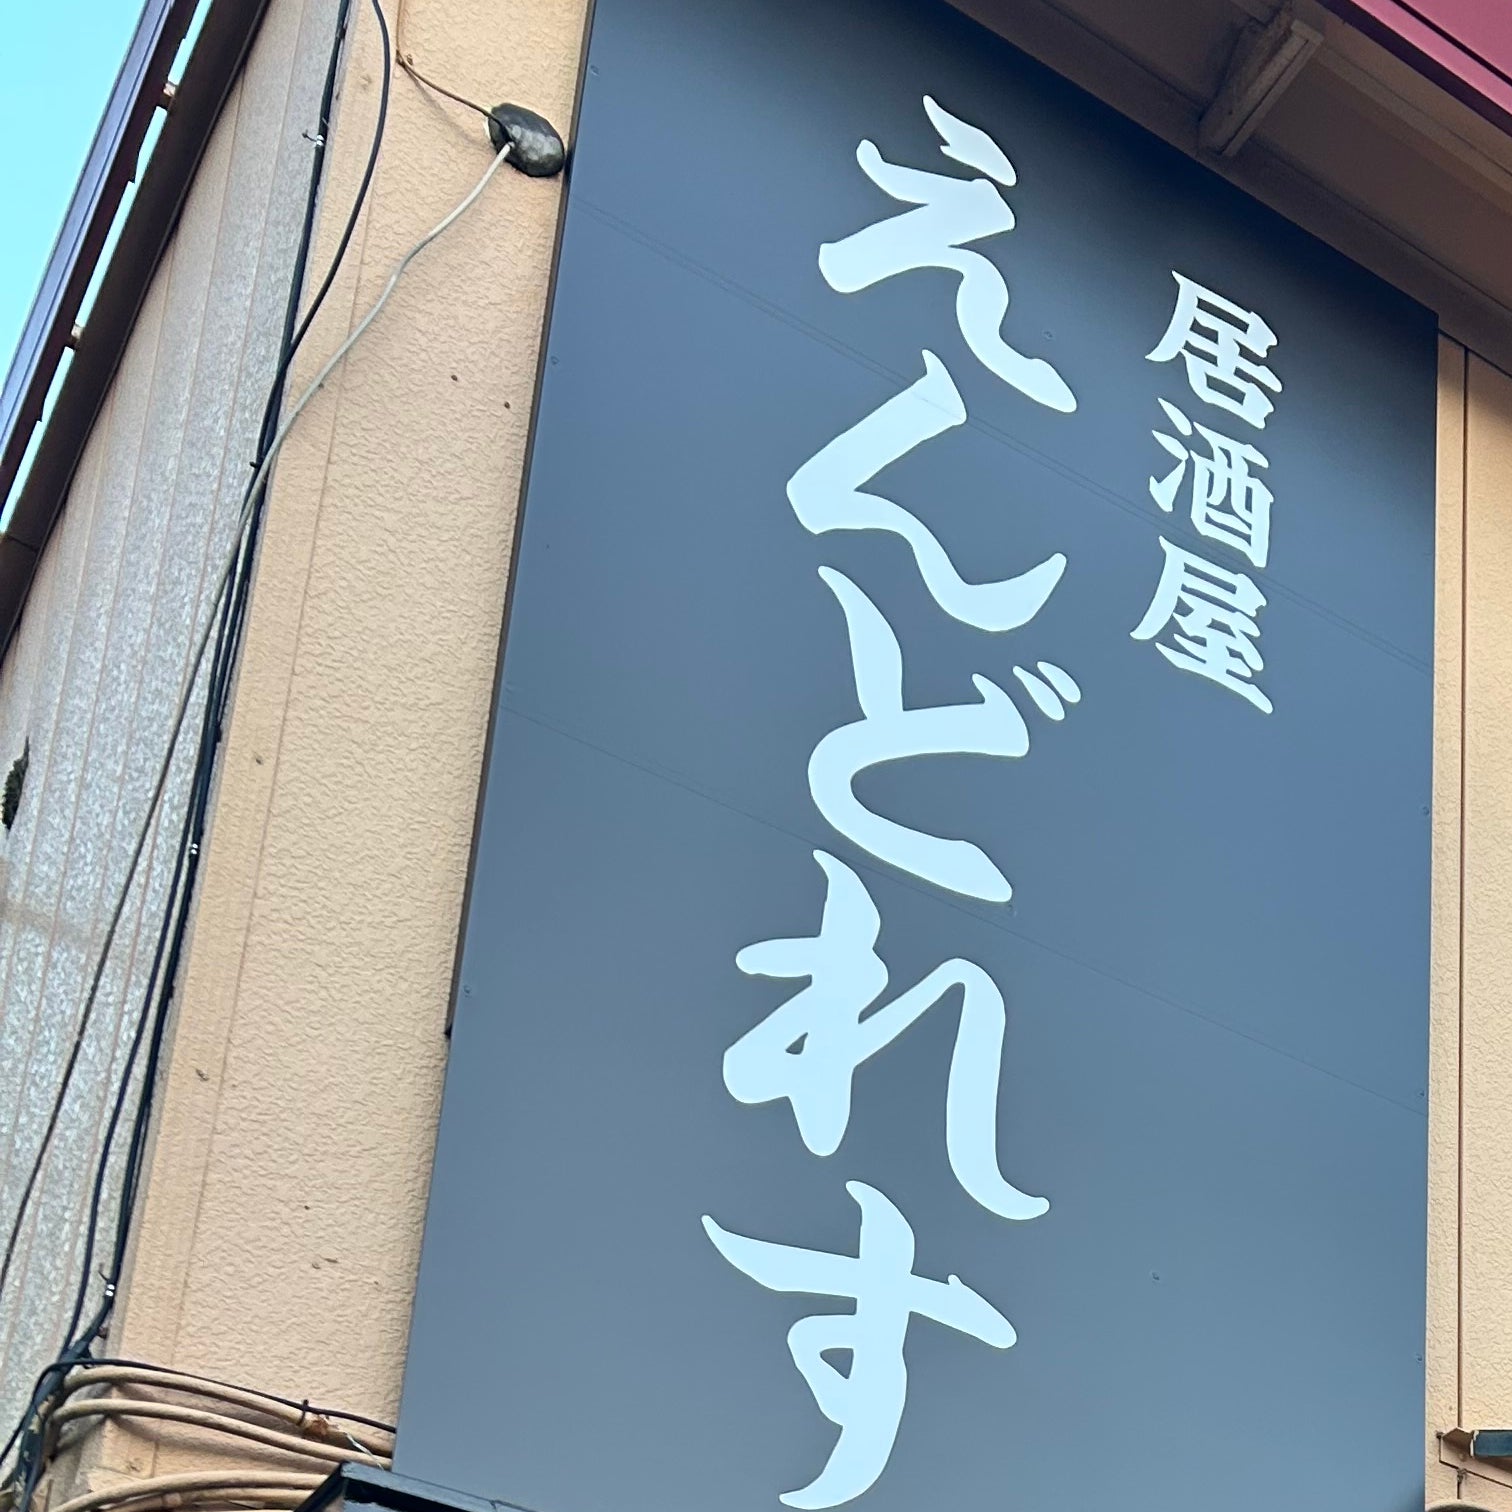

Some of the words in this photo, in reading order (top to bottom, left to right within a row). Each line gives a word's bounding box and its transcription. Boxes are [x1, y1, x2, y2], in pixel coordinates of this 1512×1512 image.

[702, 96, 1080, 1510] えんどれす
[1130, 271, 1283, 714] 居酒屋
